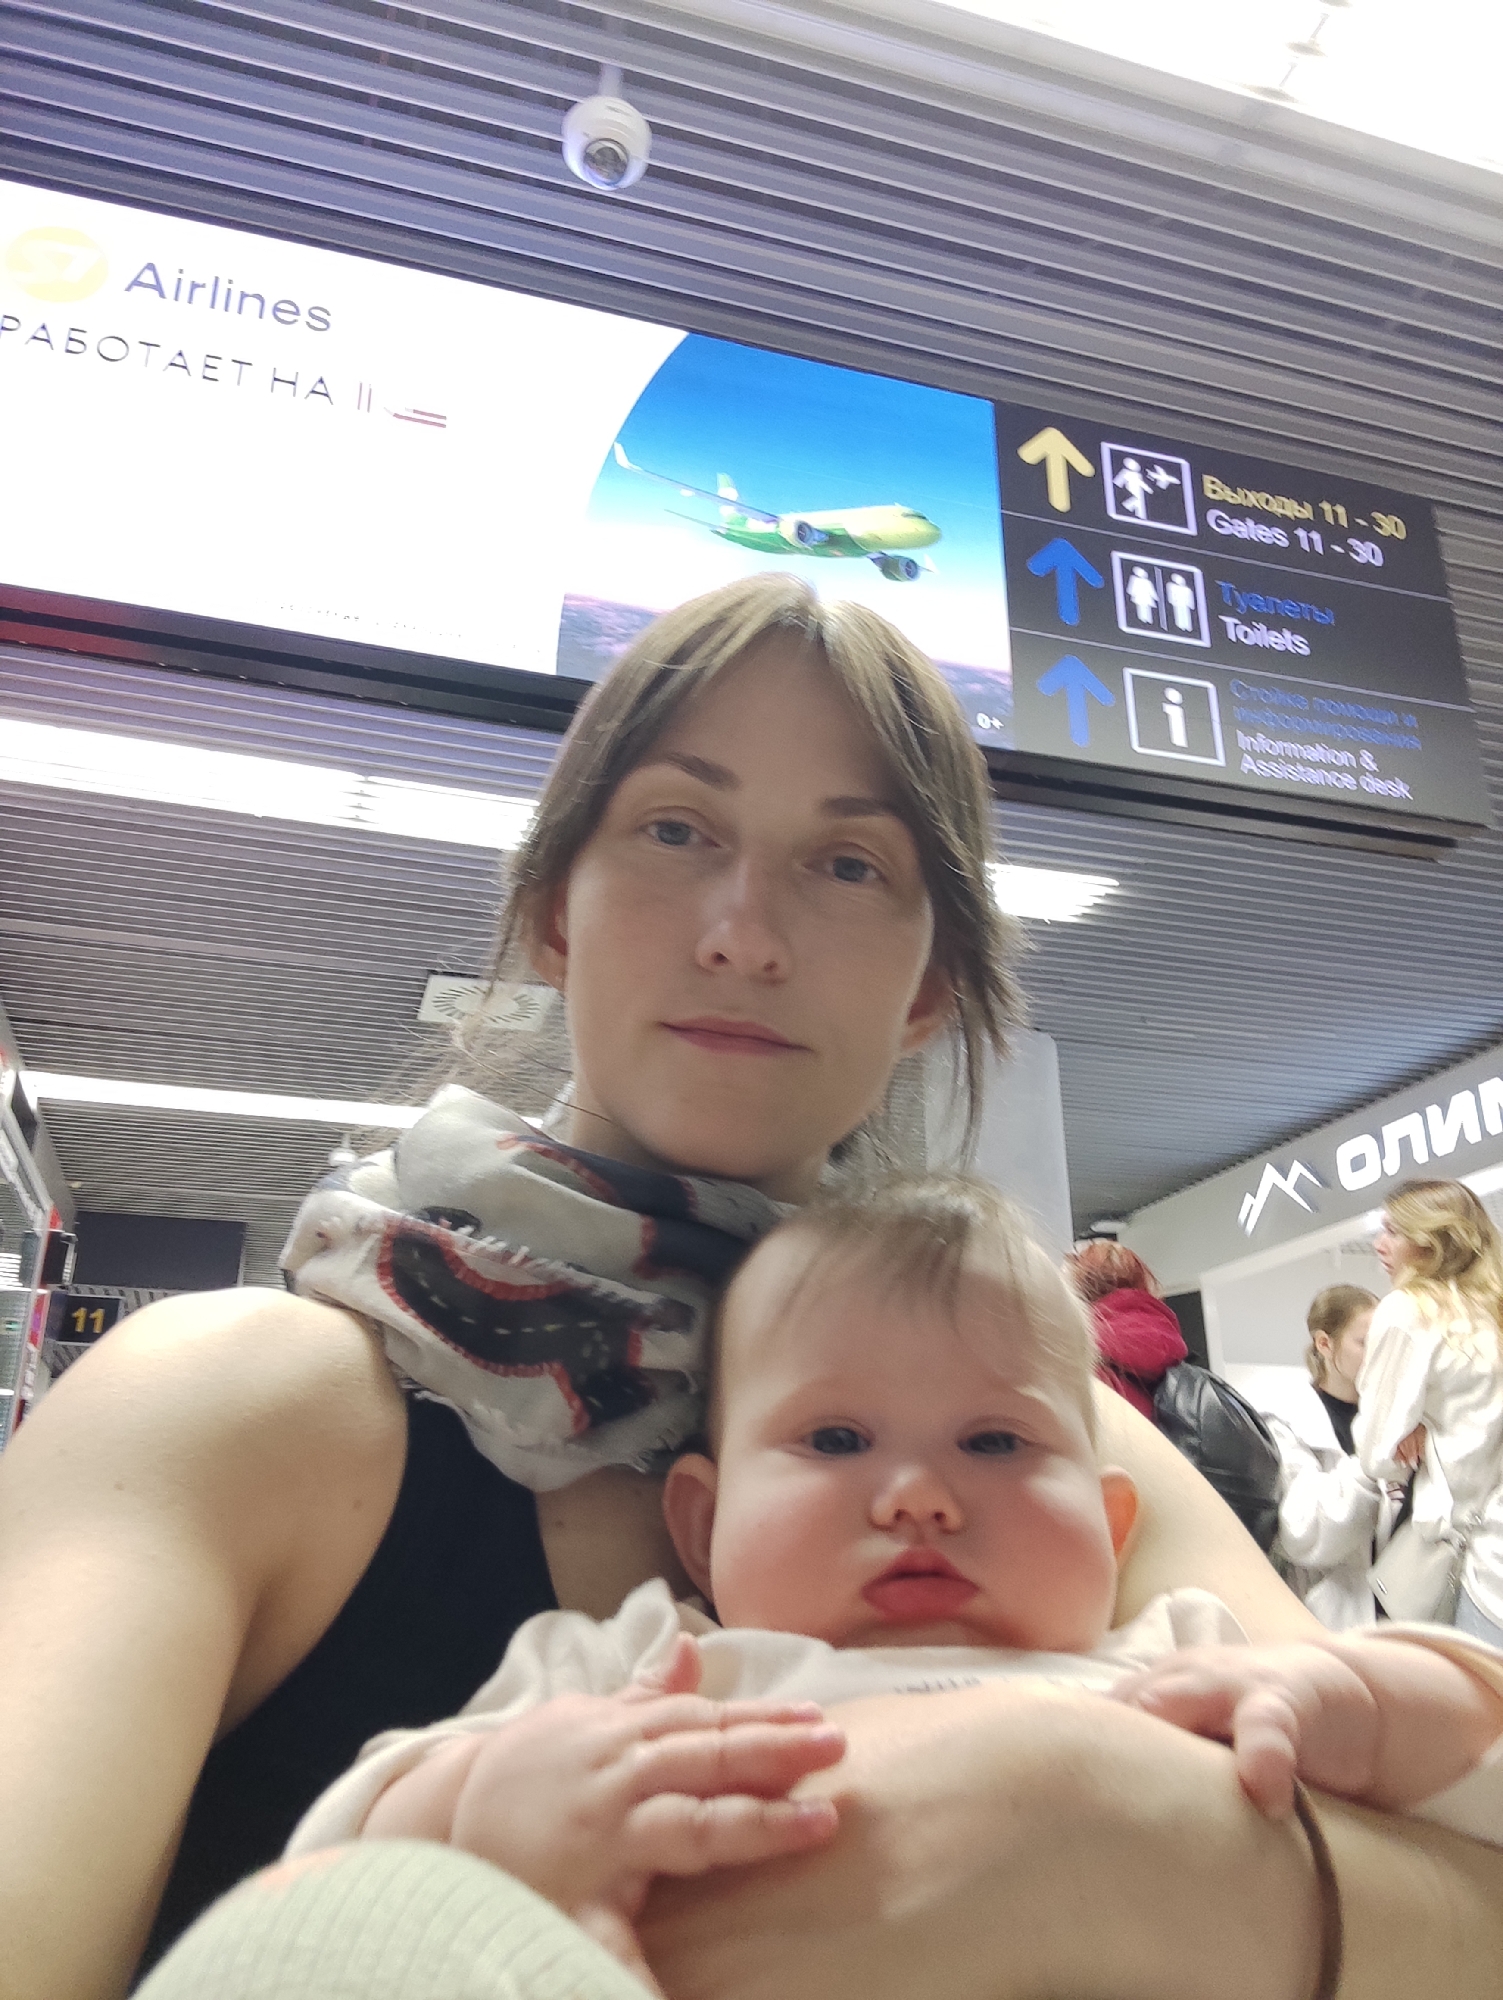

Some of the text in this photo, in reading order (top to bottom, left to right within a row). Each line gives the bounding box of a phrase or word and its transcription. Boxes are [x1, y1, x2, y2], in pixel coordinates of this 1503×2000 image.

[124, 262, 332, 332] Airlines
[0, 314, 253, 386] РАБОТАЕТ
[271, 367, 334, 406] НА
[1202, 474, 1314, 521] Выходы
[1319, 499, 1348, 528] 11
[1370, 511, 1407, 540] 30
[1206, 508, 1290, 548] Gates
[1294, 527, 1324, 556] 11
[1347, 537, 1384, 567] 30
[1218, 615, 1311, 656] Toilets
[976, 712, 1005, 730] 0+
[1236, 728, 1380, 772] Information &
[1240, 753, 1413, 801] Assistance desk
[72, 1306, 106, 1334] 11
